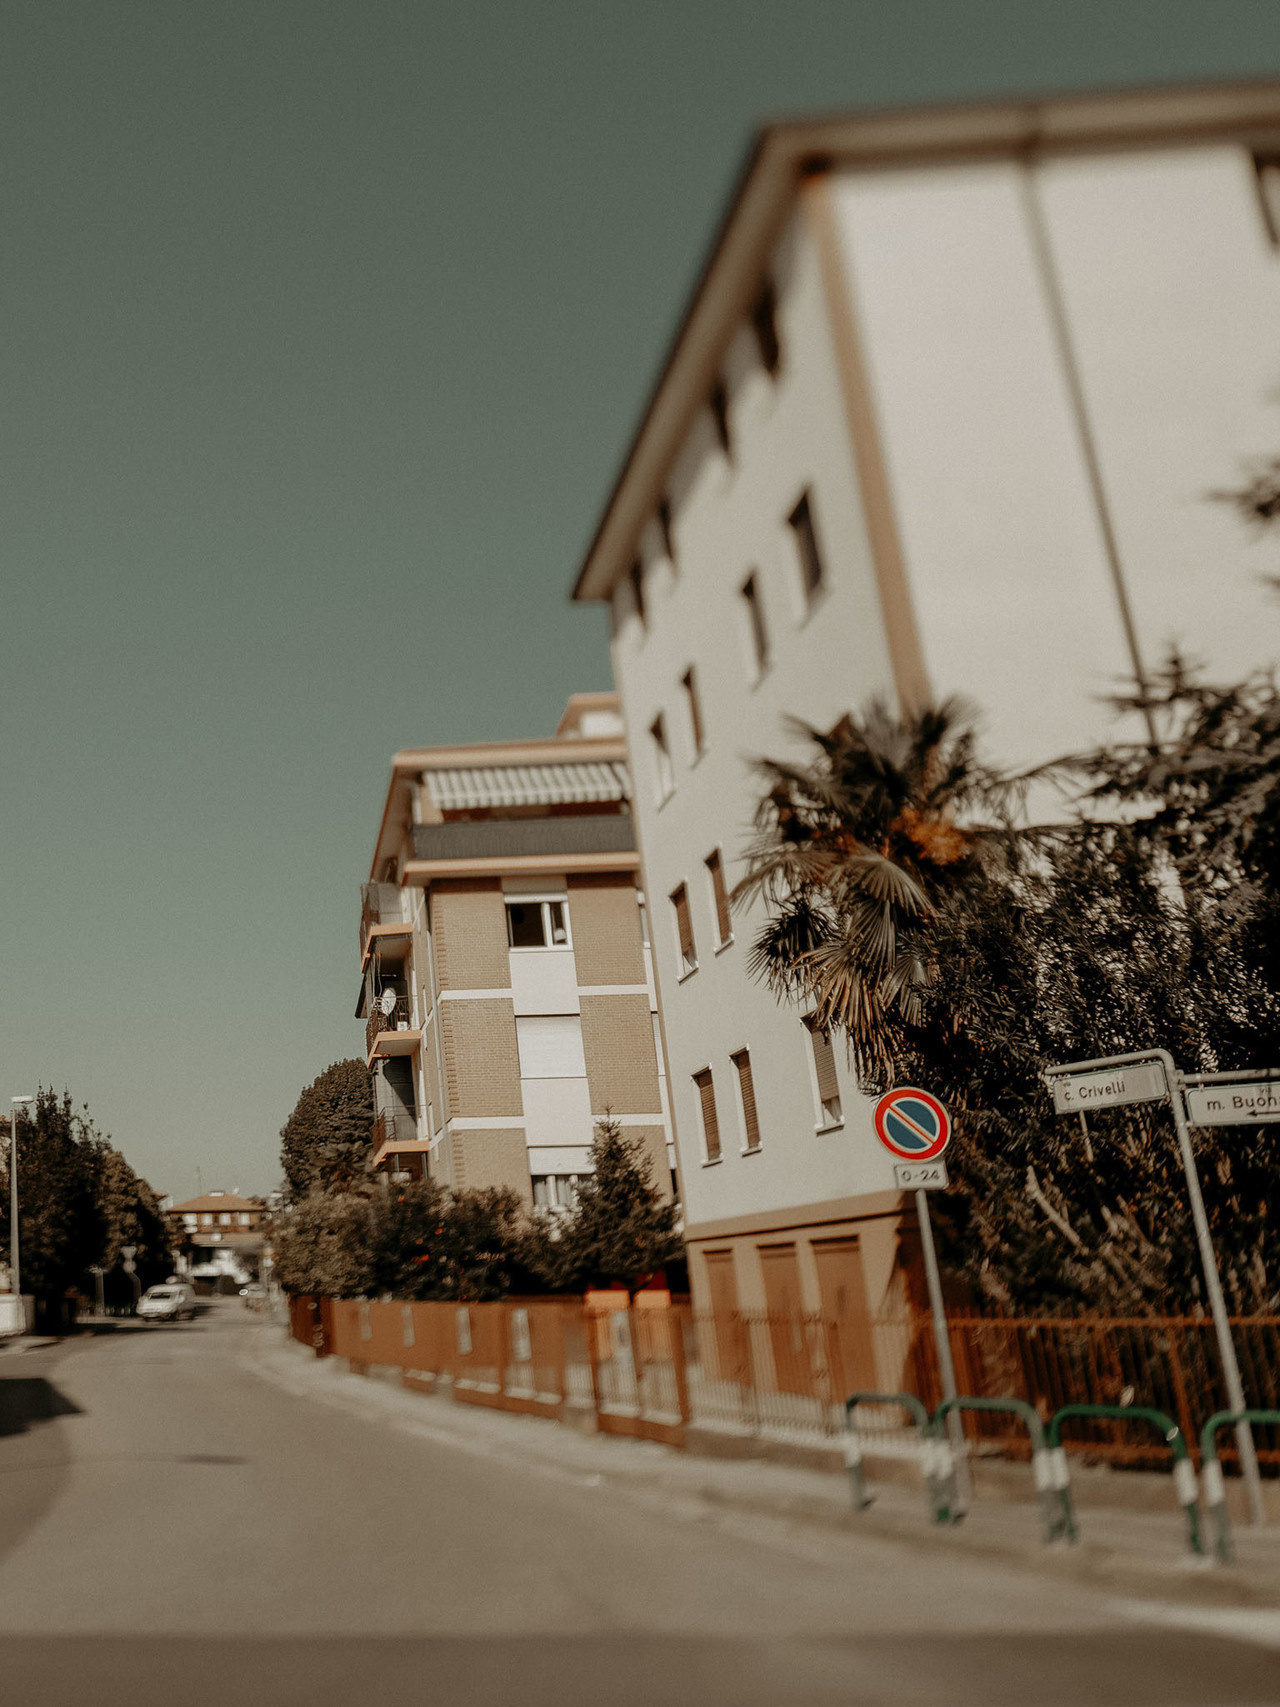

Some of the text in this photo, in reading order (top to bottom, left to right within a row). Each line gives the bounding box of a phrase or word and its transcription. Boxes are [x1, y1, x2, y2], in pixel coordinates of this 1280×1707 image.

[1079, 1081, 1126, 1099] Crivelli
[1206, 1096, 1280, 1110] m. Buon
